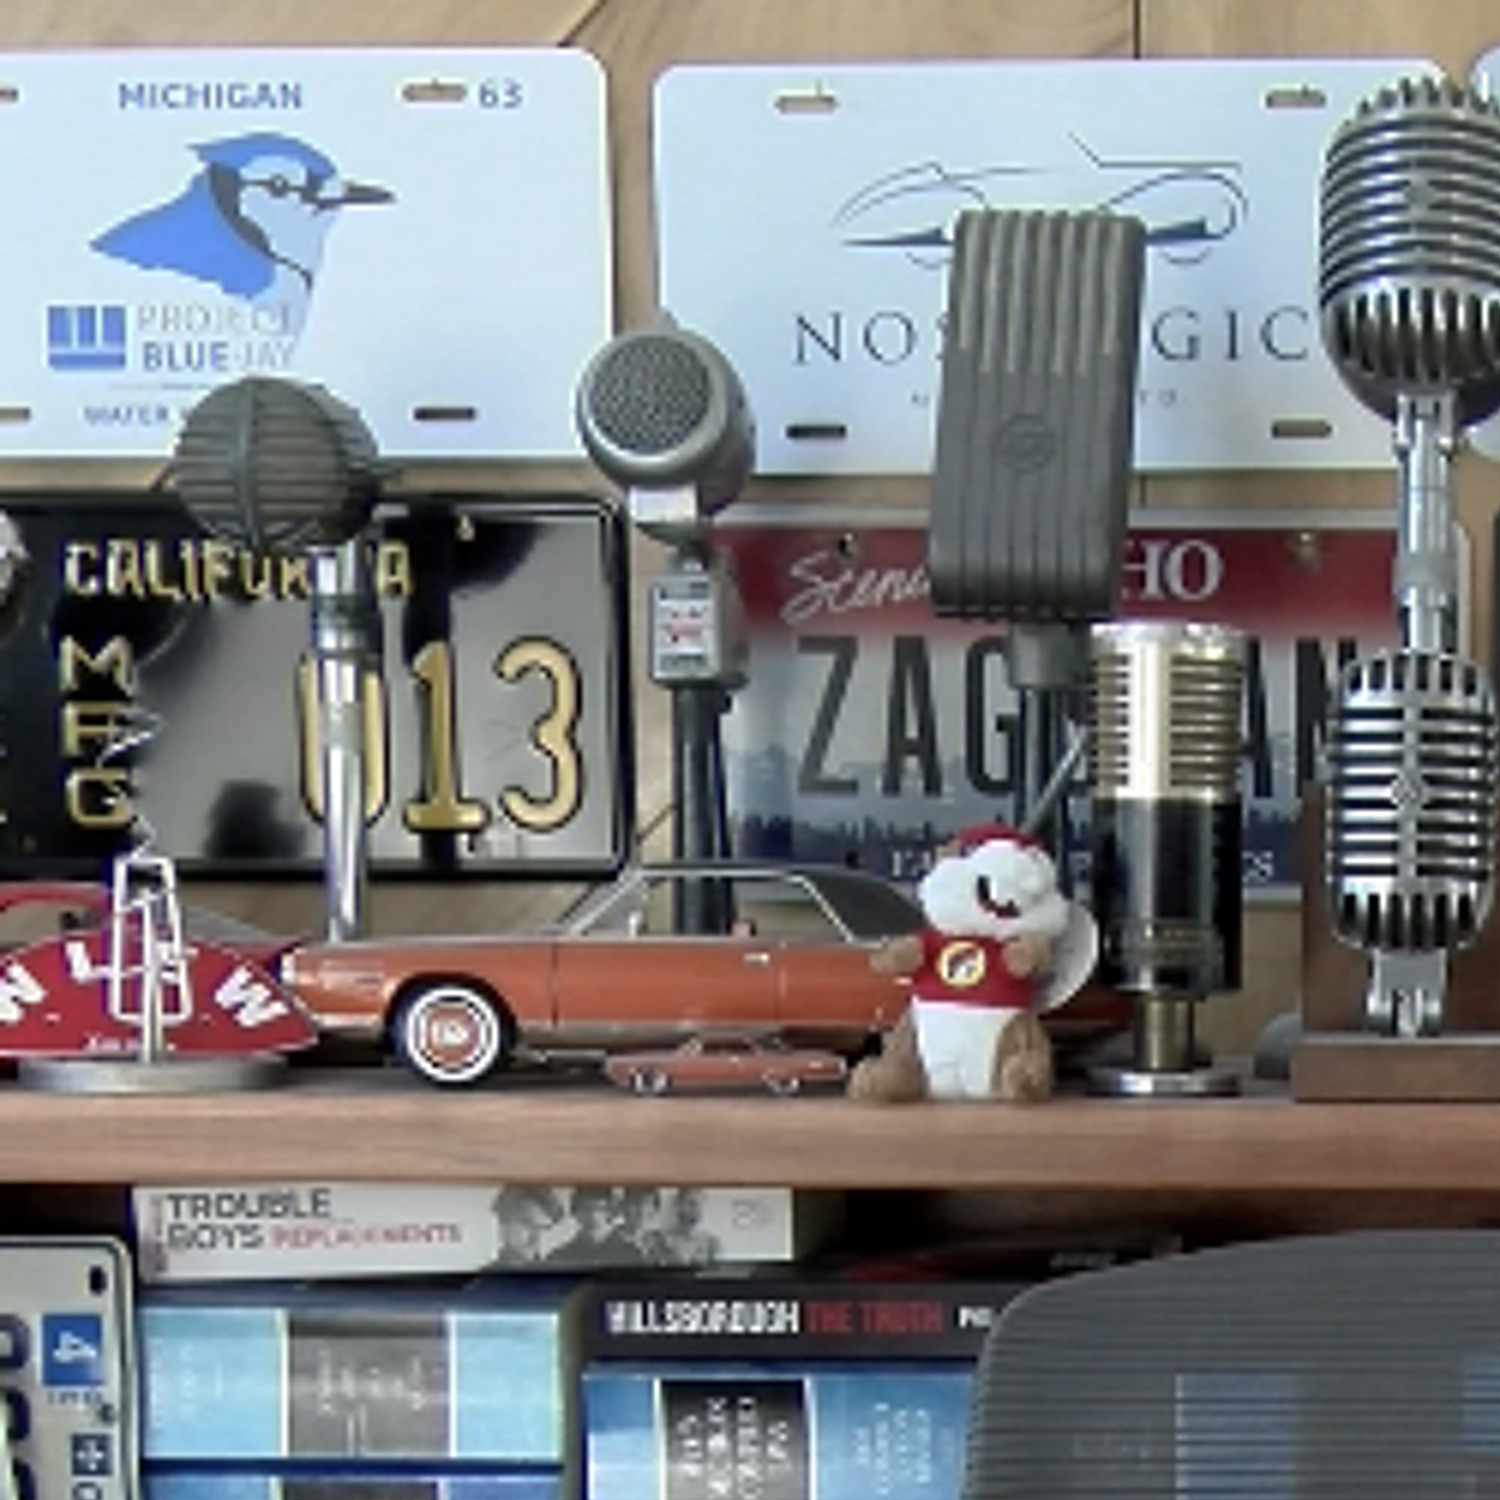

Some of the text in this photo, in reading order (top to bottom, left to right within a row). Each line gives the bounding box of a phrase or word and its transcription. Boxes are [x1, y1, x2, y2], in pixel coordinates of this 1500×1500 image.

[118, 82, 302, 109] MICHIGAN
[477, 80, 523, 107] 63
[137, 304, 291, 332] PROJECT
[794, 305, 1310, 366] NOGIC
[142, 341, 230, 372] BLUE
[63, 540, 411, 601] CALIFORA
[165, 1188, 332, 1219] TROUBLE
[166, 1222, 264, 1250] BOYS
[606, 1300, 800, 1334] HILLSBOROUGH
[809, 1302, 854, 1333] THE
[861, 1302, 943, 1333] TRUTH
[51, 1329, 98, 1363] 4
